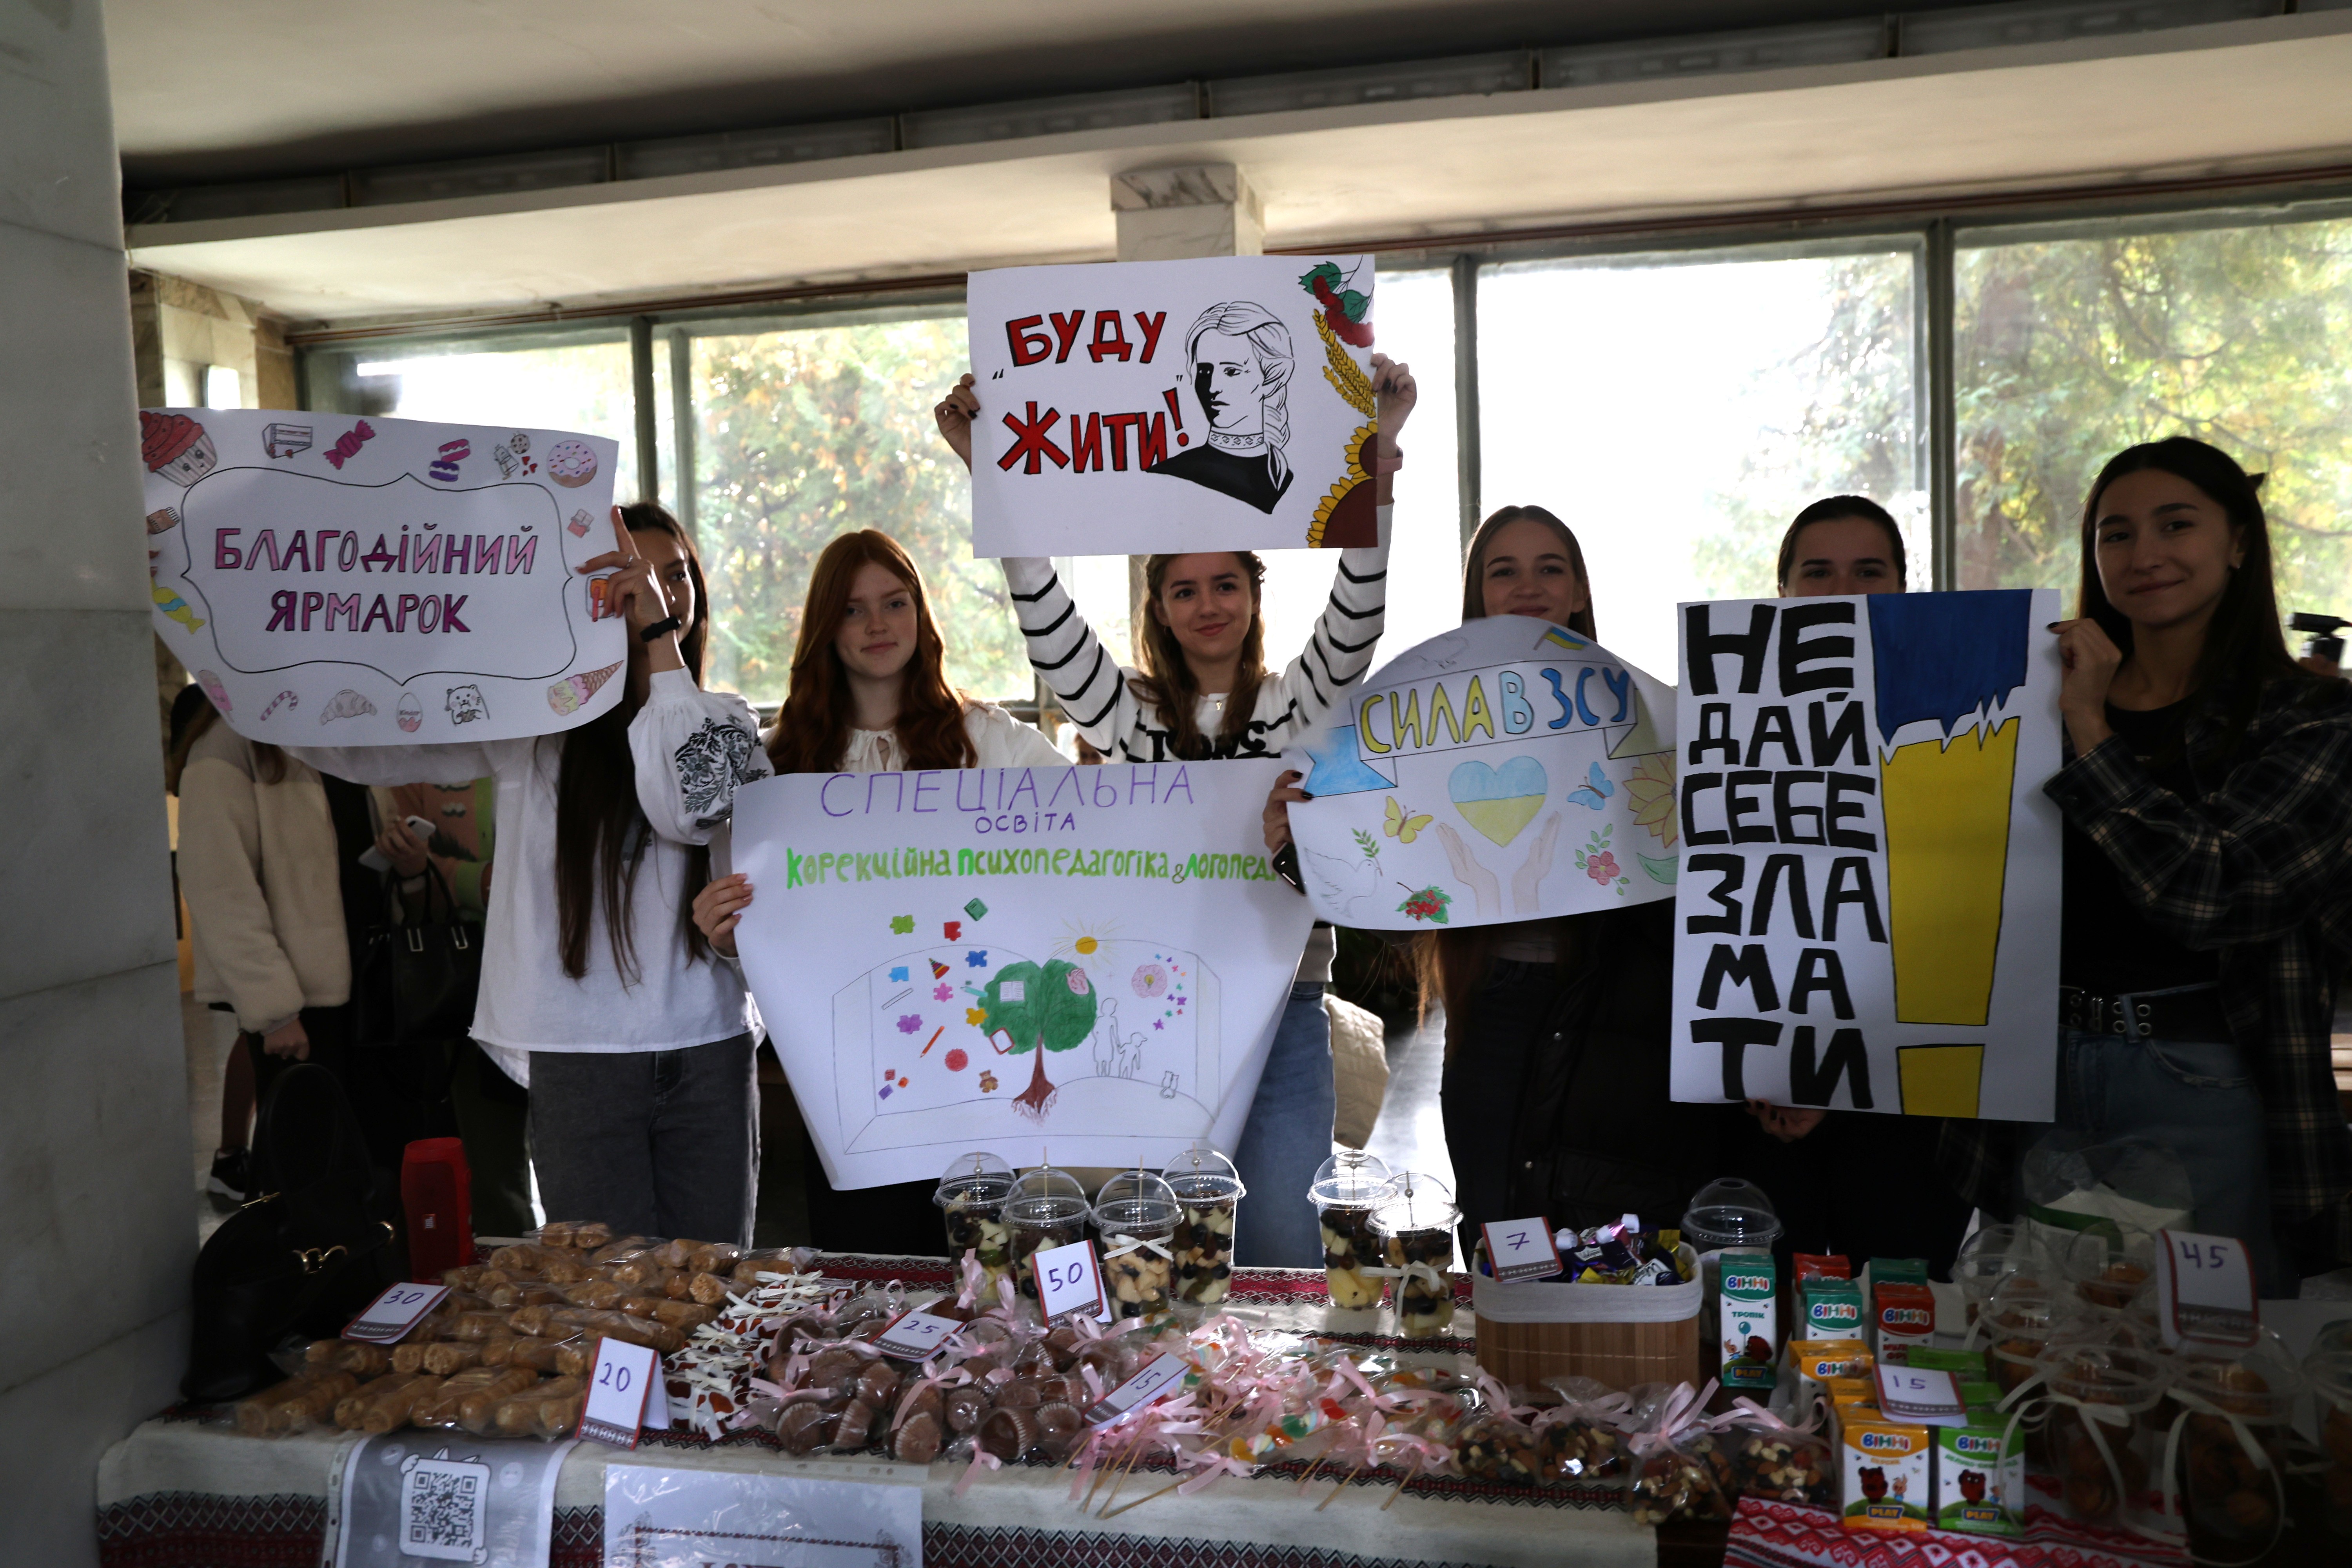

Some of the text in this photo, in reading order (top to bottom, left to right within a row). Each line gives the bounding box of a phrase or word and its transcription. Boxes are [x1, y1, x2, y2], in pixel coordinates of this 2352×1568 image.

[214, 523, 539, 575] БЛАГОДІЙНИЙ
[265, 590, 470, 633] ЯРМАРОК
[1685, 601, 1855, 697] НЕ
[1359, 666, 1629, 753] СИЛА В ЗСУ
[1688, 691, 1871, 767] ДАЙ
[821, 764, 1194, 817] СПЕЦІАЛЬНА
[1681, 770, 1878, 852] СЕБЕ
[1171, 863, 1185, 884] &
[1183, 853, 1279, 882] Логопед
[1686, 853, 1888, 944] ЗЛА
[1696, 944, 1855, 1020] МА
[1690, 1017, 1874, 1109] ТИ
[1506, 1232, 1530, 1250] 7
[2180, 1240, 2229, 1269] 45
[1048, 1261, 1083, 1292] 50
[383, 1290, 425, 1305] 30
[902, 1320, 940, 1334] 25
[599, 1362, 631, 1392] 20
[1130, 1369, 1161, 1390] 15
[1892, 1375, 1926, 1390] 15
[1957, 1436, 2002, 1452] ВІНН
[1870, 1508, 1900, 1518] PLAY
[1965, 1510, 1996, 1520] PLAY
